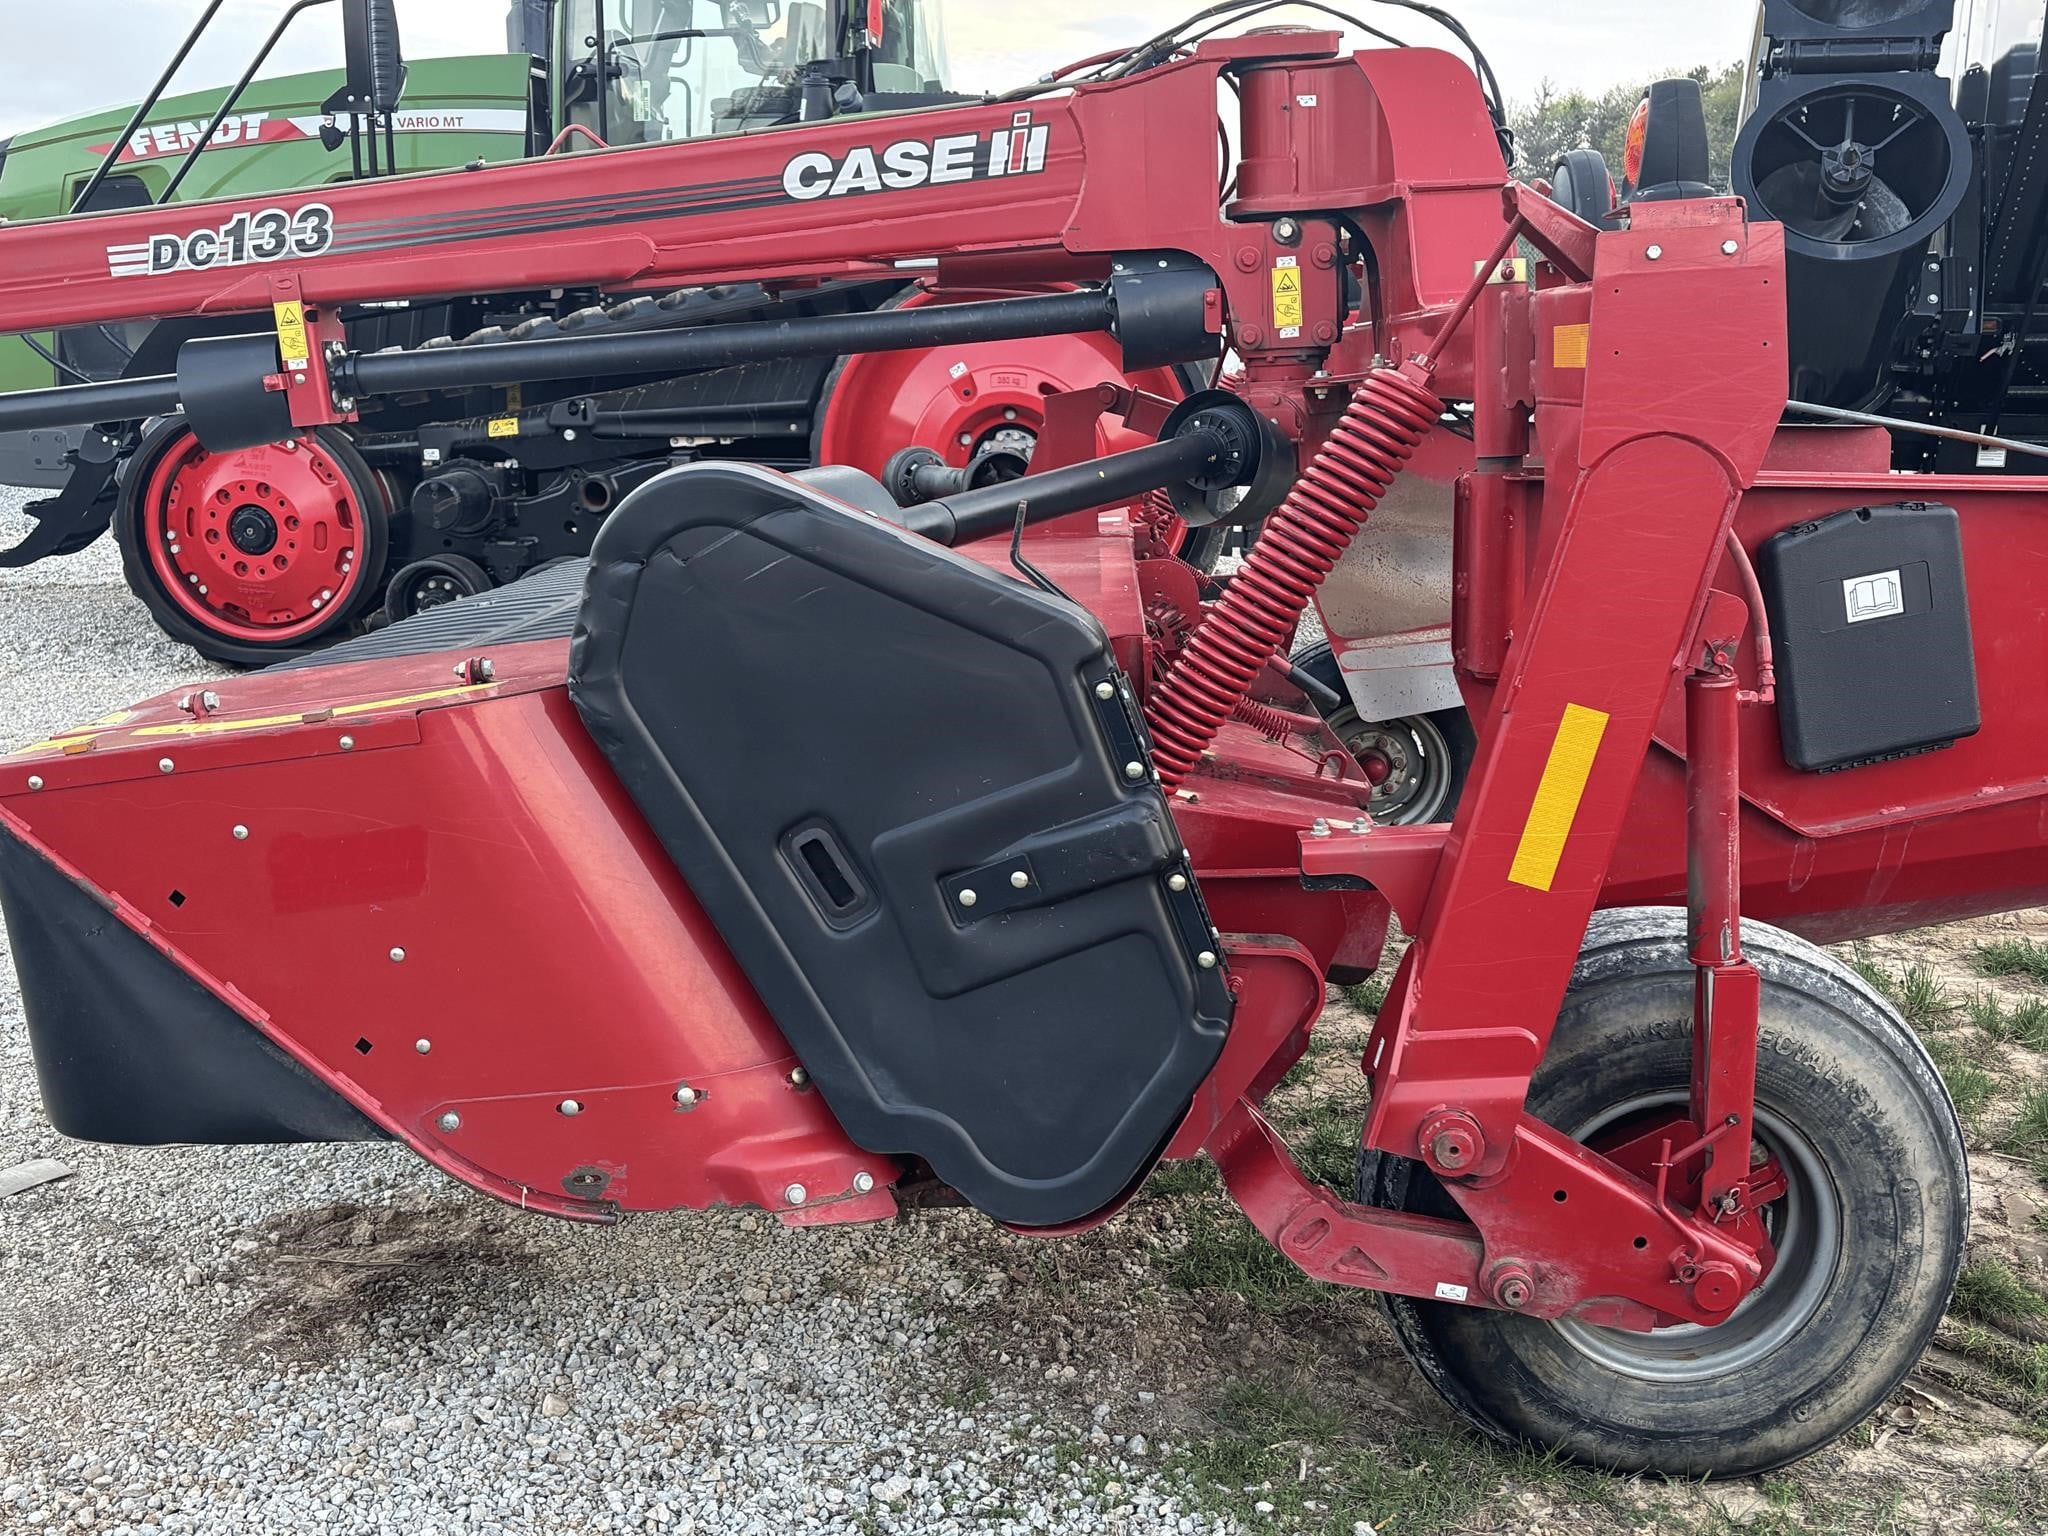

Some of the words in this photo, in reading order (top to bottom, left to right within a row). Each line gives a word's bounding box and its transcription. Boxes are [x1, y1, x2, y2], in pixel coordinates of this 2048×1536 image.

[129, 112, 270, 156] FENDT
[397, 116, 440, 129] VARIO
[443, 116, 464, 128] MT
[783, 134, 978, 200] CASE
[149, 203, 334, 275] DC133
